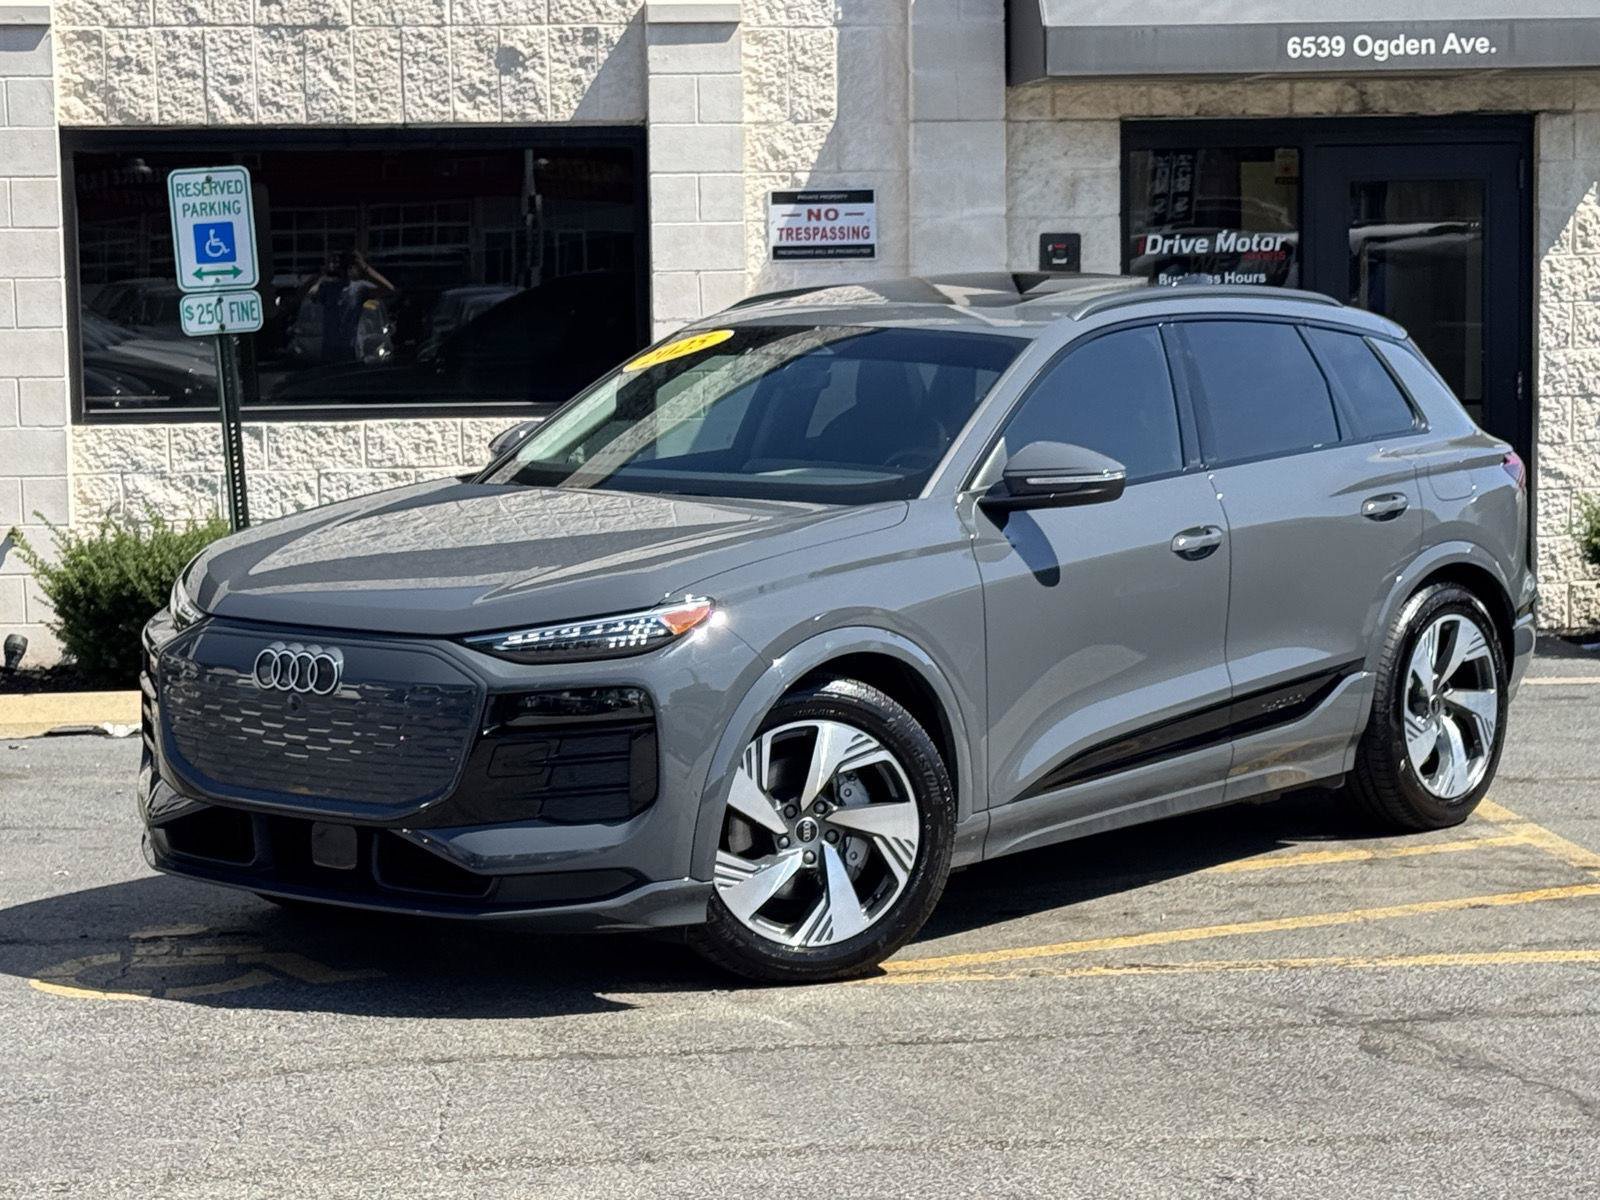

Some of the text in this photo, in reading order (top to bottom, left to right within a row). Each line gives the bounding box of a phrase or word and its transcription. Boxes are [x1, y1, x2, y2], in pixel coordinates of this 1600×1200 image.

[1286, 32, 1497, 62] 6539 Ogden Ave.
[175, 179, 244, 199] RESERVED
[182, 199, 242, 218] PARKING
[806, 208, 839, 222] NO
[777, 225, 871, 242] TRESPASSING
[1214, 231, 1289, 254] Motor
[1223, 271, 1267, 285] Hours
[184, 300, 259, 326] $250 FINE
